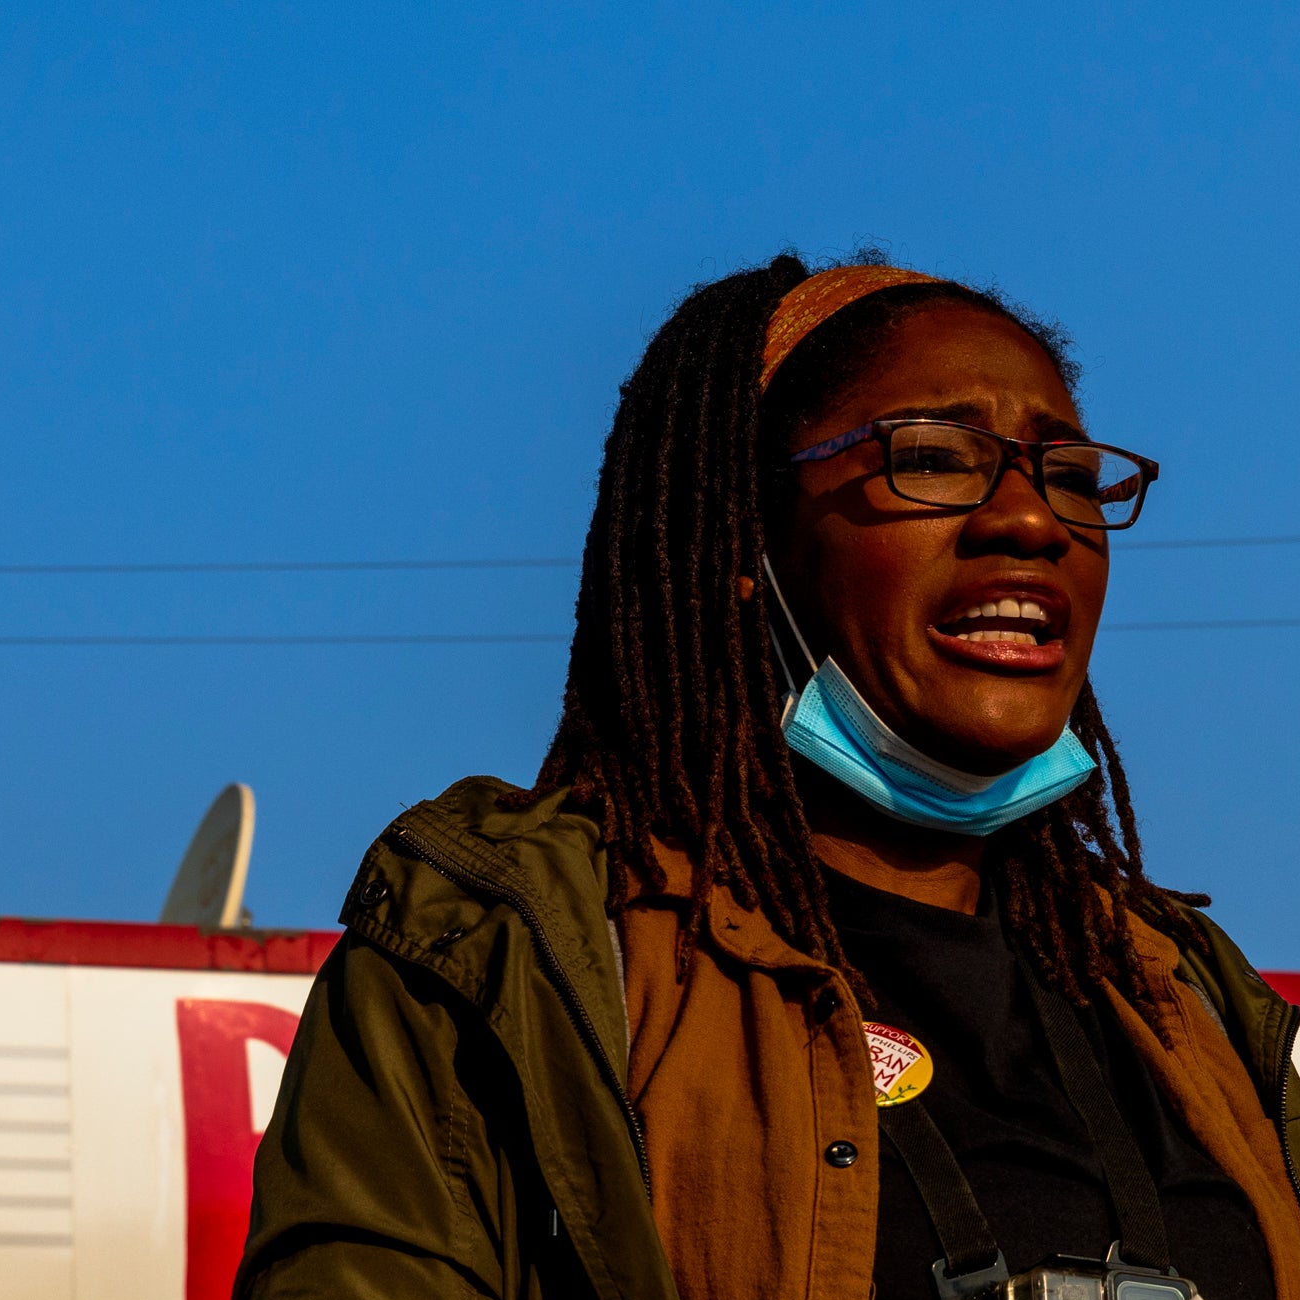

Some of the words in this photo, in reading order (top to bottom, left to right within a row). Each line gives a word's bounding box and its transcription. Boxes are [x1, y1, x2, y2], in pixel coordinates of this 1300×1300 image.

[862, 1023, 916, 1048] SUPPORT
[869, 1045, 911, 1075] BAN
[871, 1036, 919, 1061] PHILLIPS
